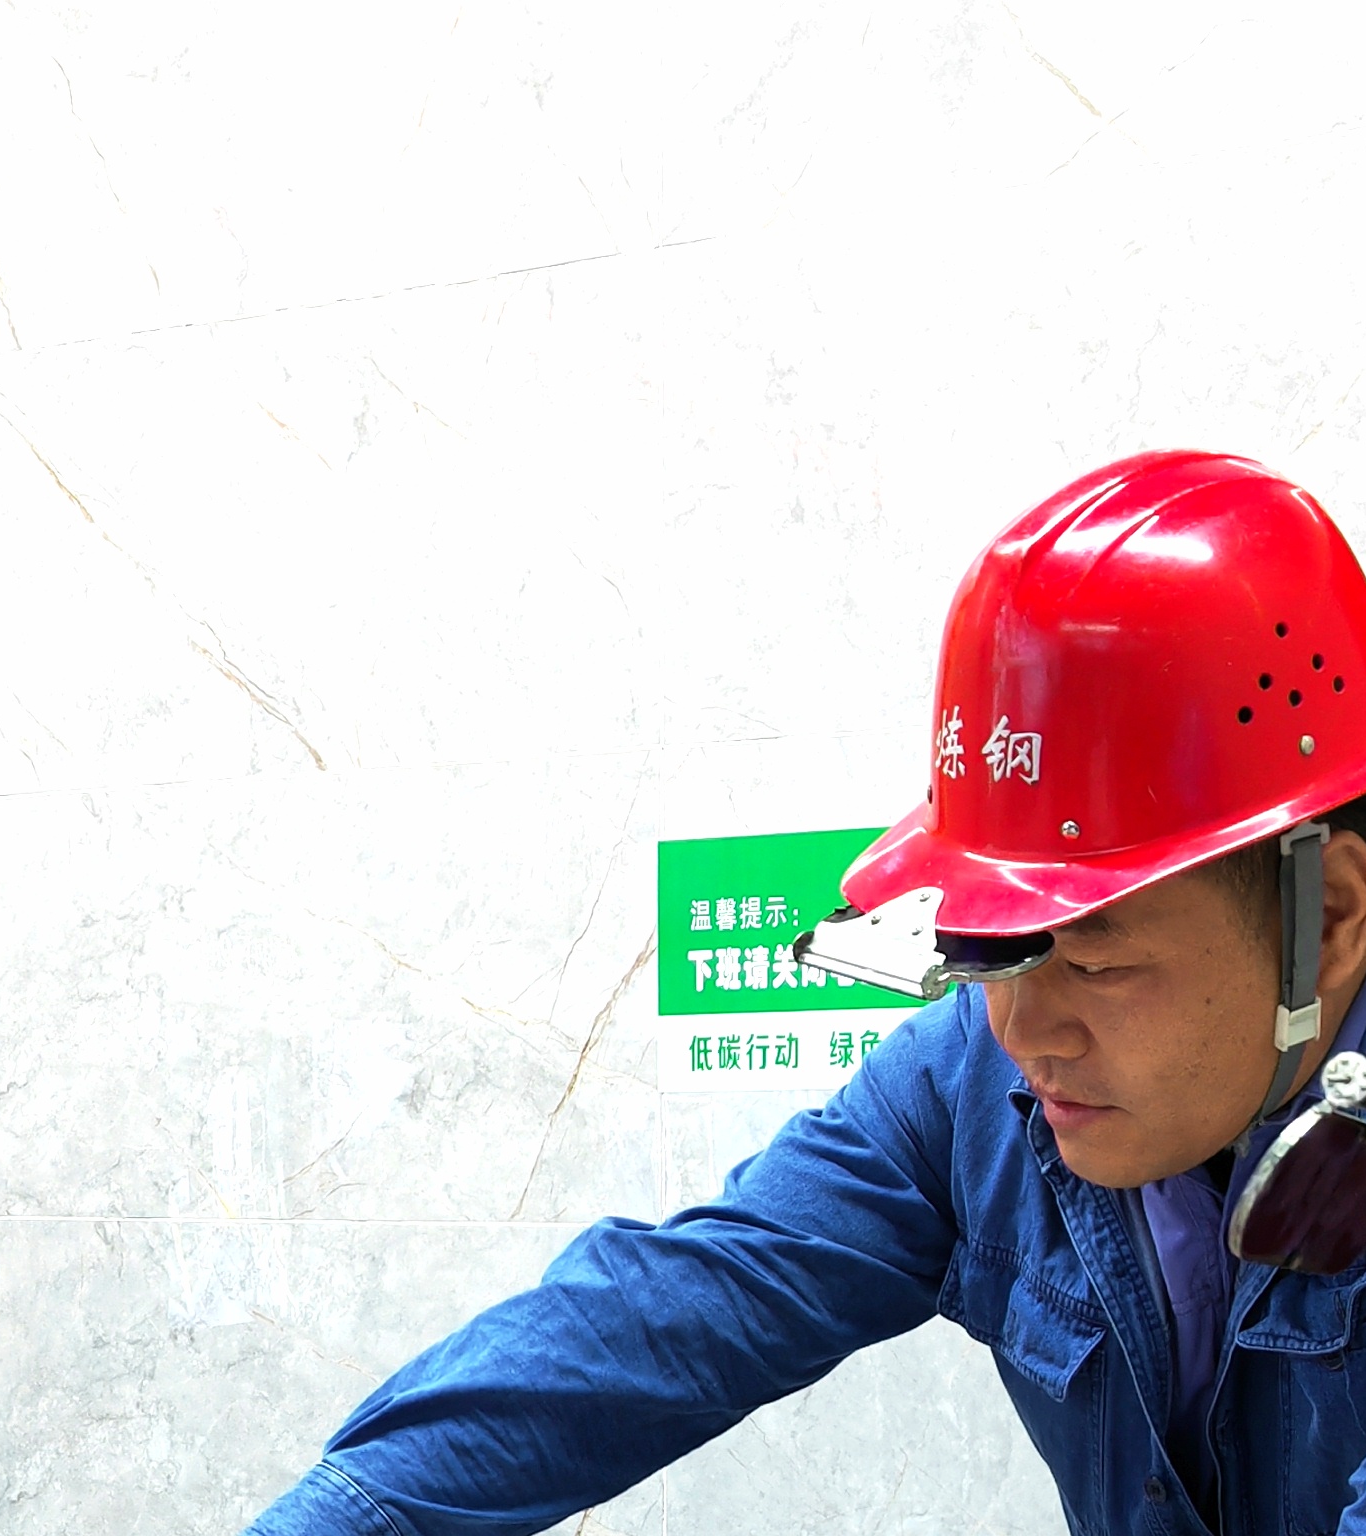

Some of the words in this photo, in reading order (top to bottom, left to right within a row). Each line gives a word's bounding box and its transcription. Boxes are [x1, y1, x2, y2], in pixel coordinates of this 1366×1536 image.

[936, 705, 1042, 785] 炼钢
[688, 944, 855, 992] 下班请关
[689, 1033, 798, 1071] 低碳行动
